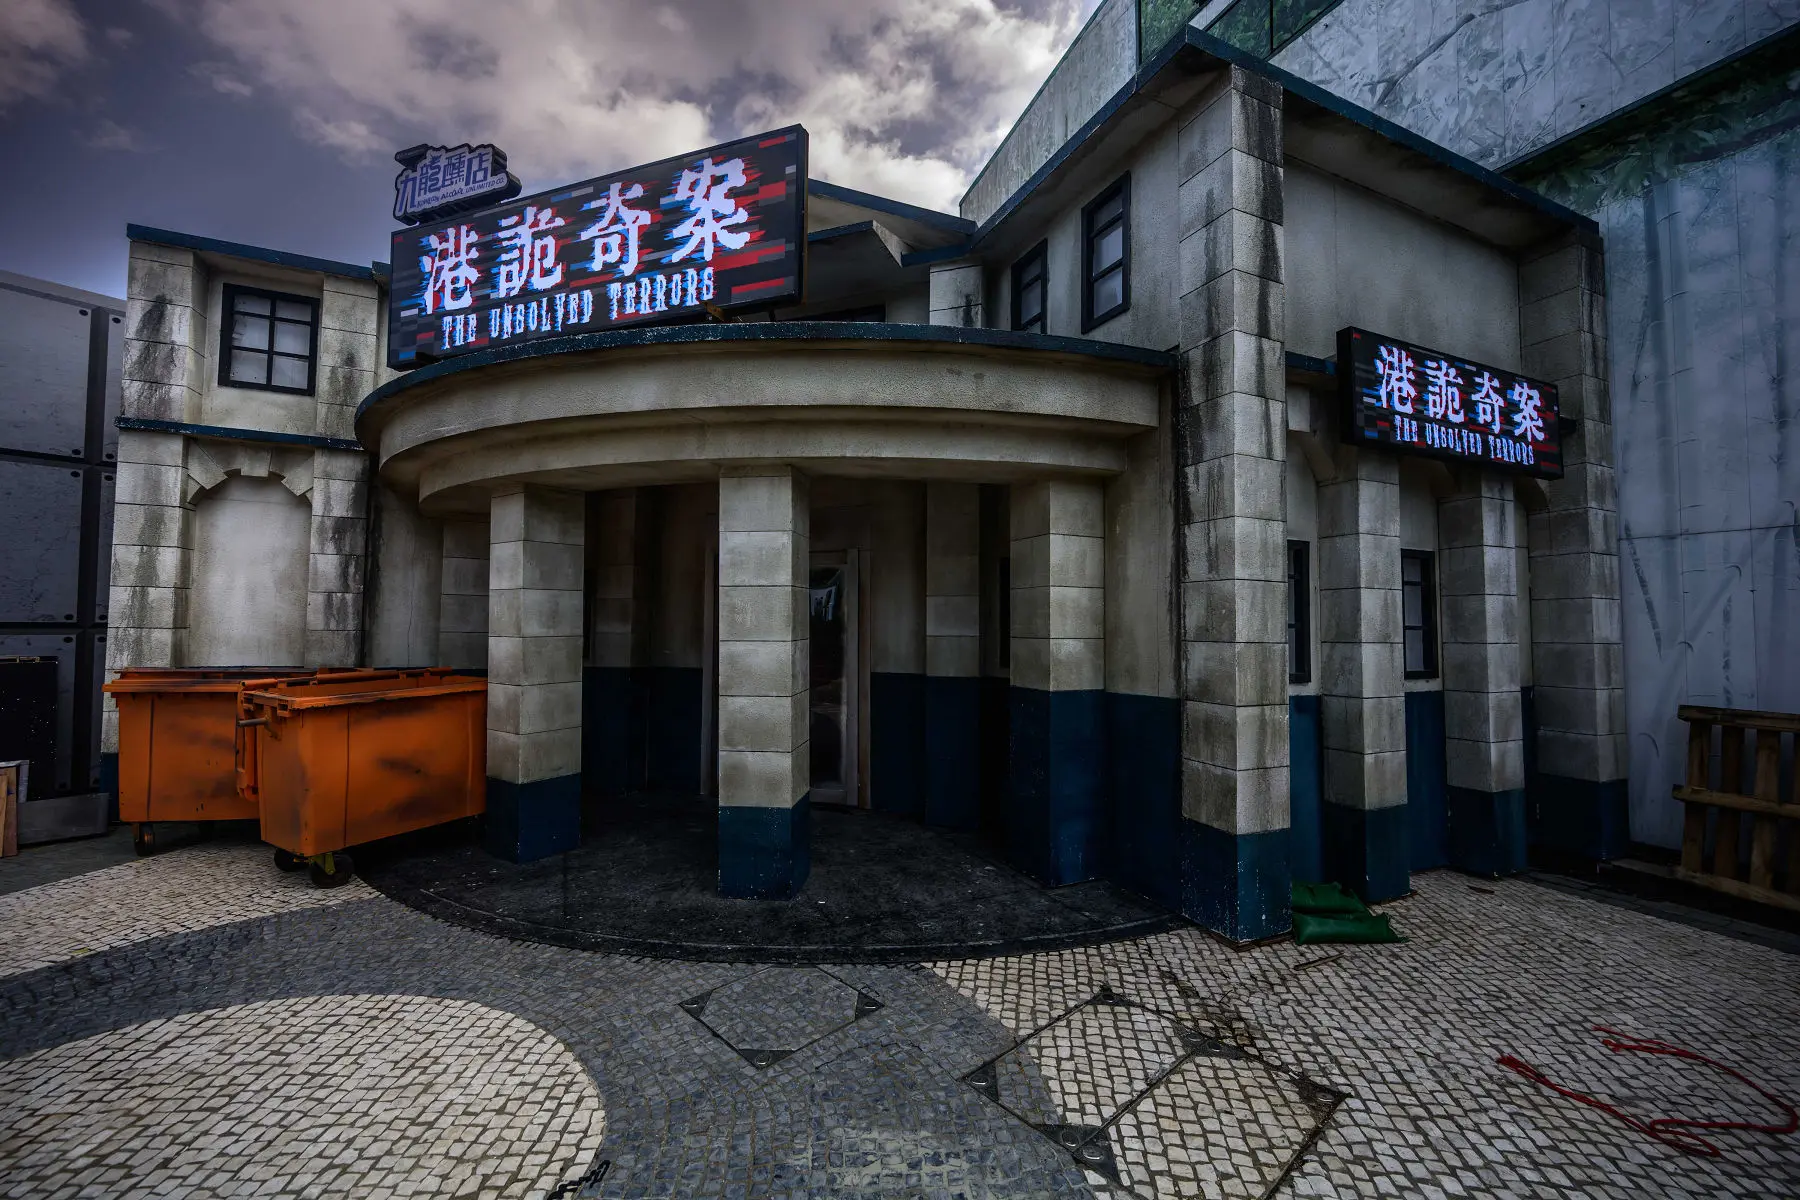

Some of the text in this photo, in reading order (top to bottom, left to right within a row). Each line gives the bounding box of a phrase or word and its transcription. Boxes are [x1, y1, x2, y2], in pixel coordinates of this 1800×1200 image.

[423, 157, 751, 316] 港詭奇案
[441, 266, 714, 350] THE UNSOLVED TERRORS
[1374, 345, 1545, 443] 港詭奇案
[1395, 414, 1534, 465] THE UNSOLVED TERRORS
